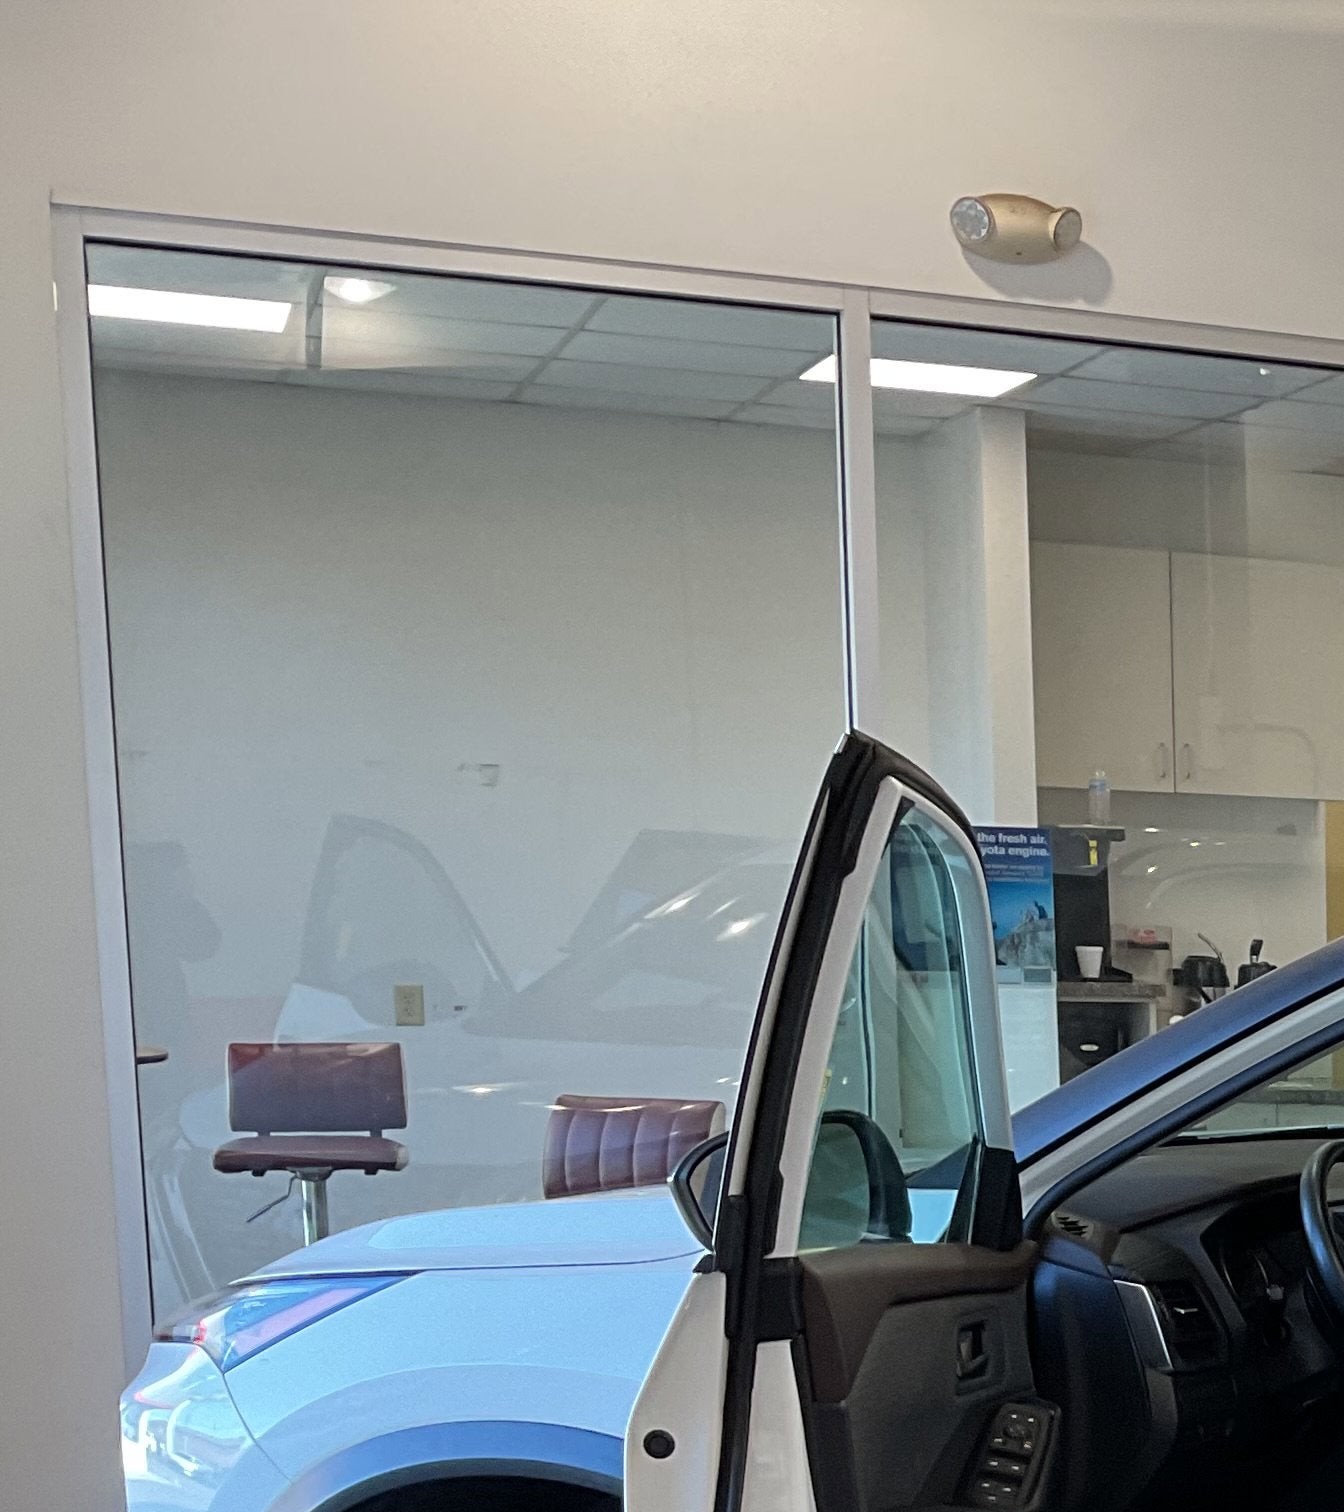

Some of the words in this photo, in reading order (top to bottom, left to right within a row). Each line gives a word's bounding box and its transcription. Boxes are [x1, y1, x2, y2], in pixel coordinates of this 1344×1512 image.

[977, 831, 997, 844] the
[998, 832, 1028, 845] fresh
[981, 845, 1006, 857] yota
